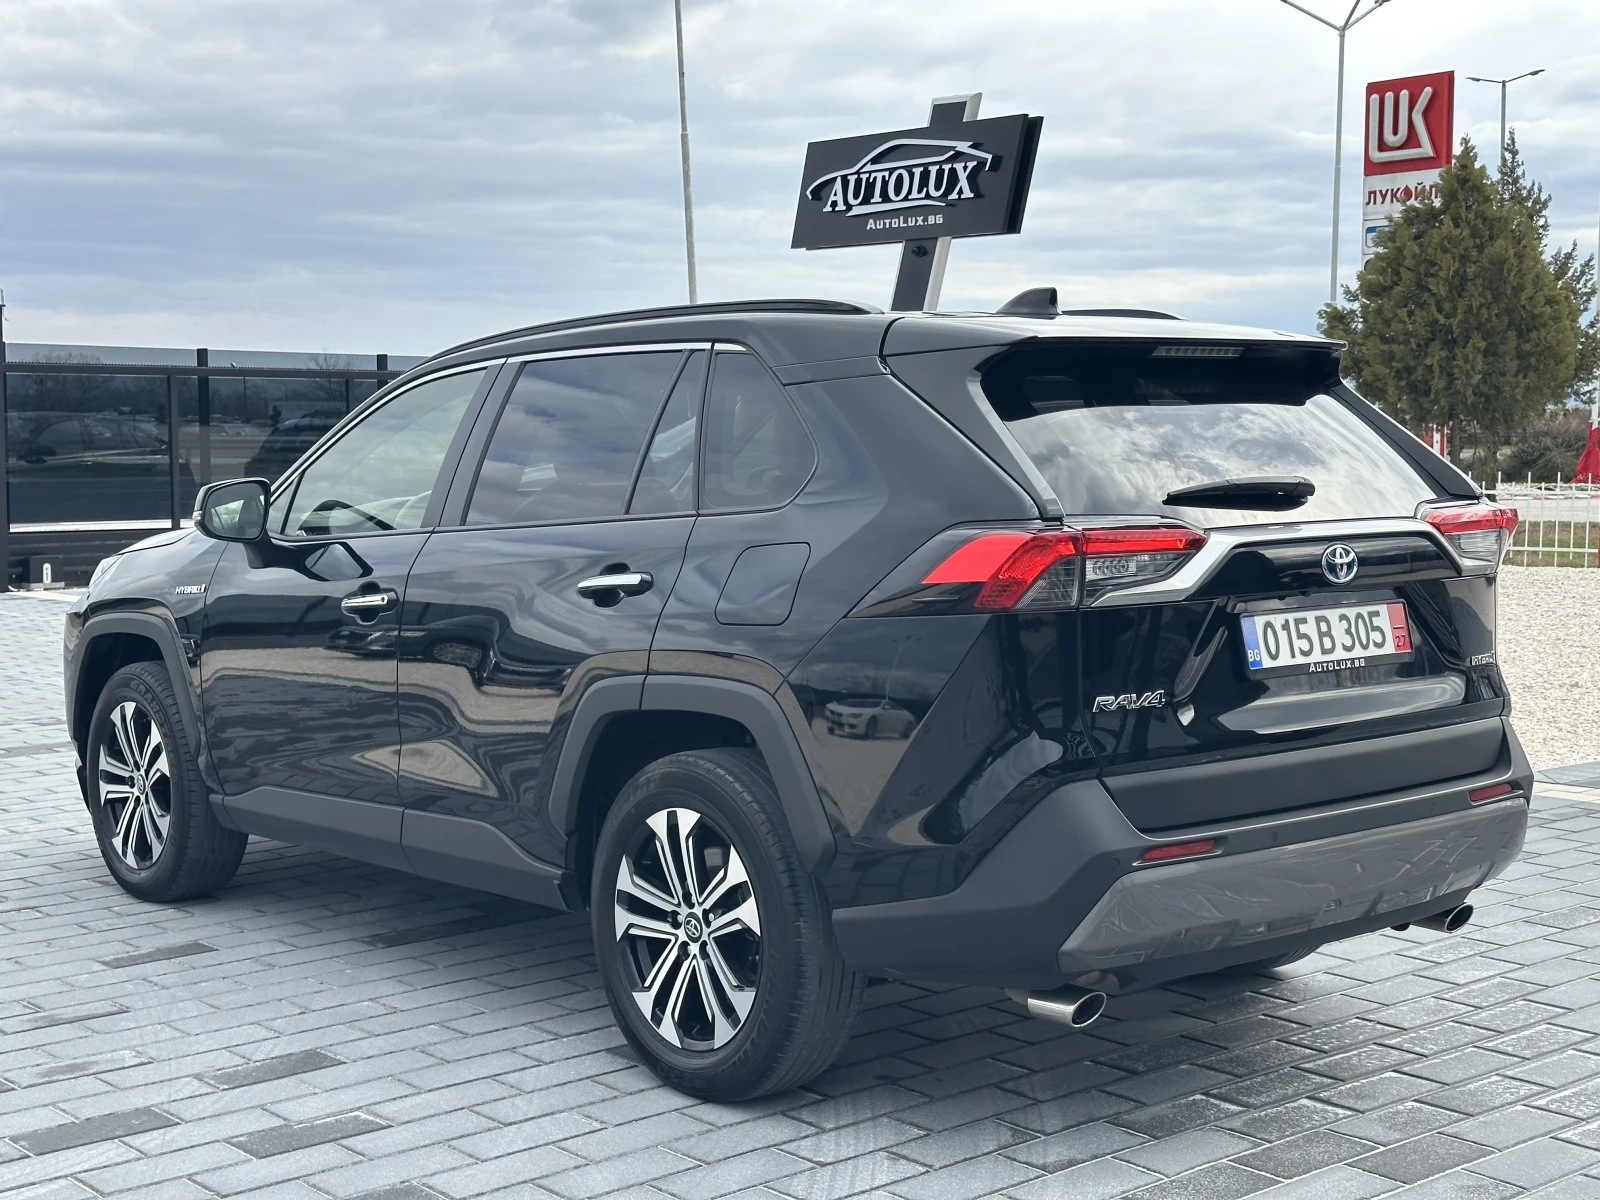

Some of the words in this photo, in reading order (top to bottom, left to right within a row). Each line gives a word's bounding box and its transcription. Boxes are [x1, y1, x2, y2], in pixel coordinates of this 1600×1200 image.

[823, 160, 978, 212] AUTOLUX
[175, 585, 201, 595] HYBRID
[1395, 633, 1406, 648] 27
[1248, 649, 1261, 661] BG
[1093, 690, 1166, 712] RAV4
